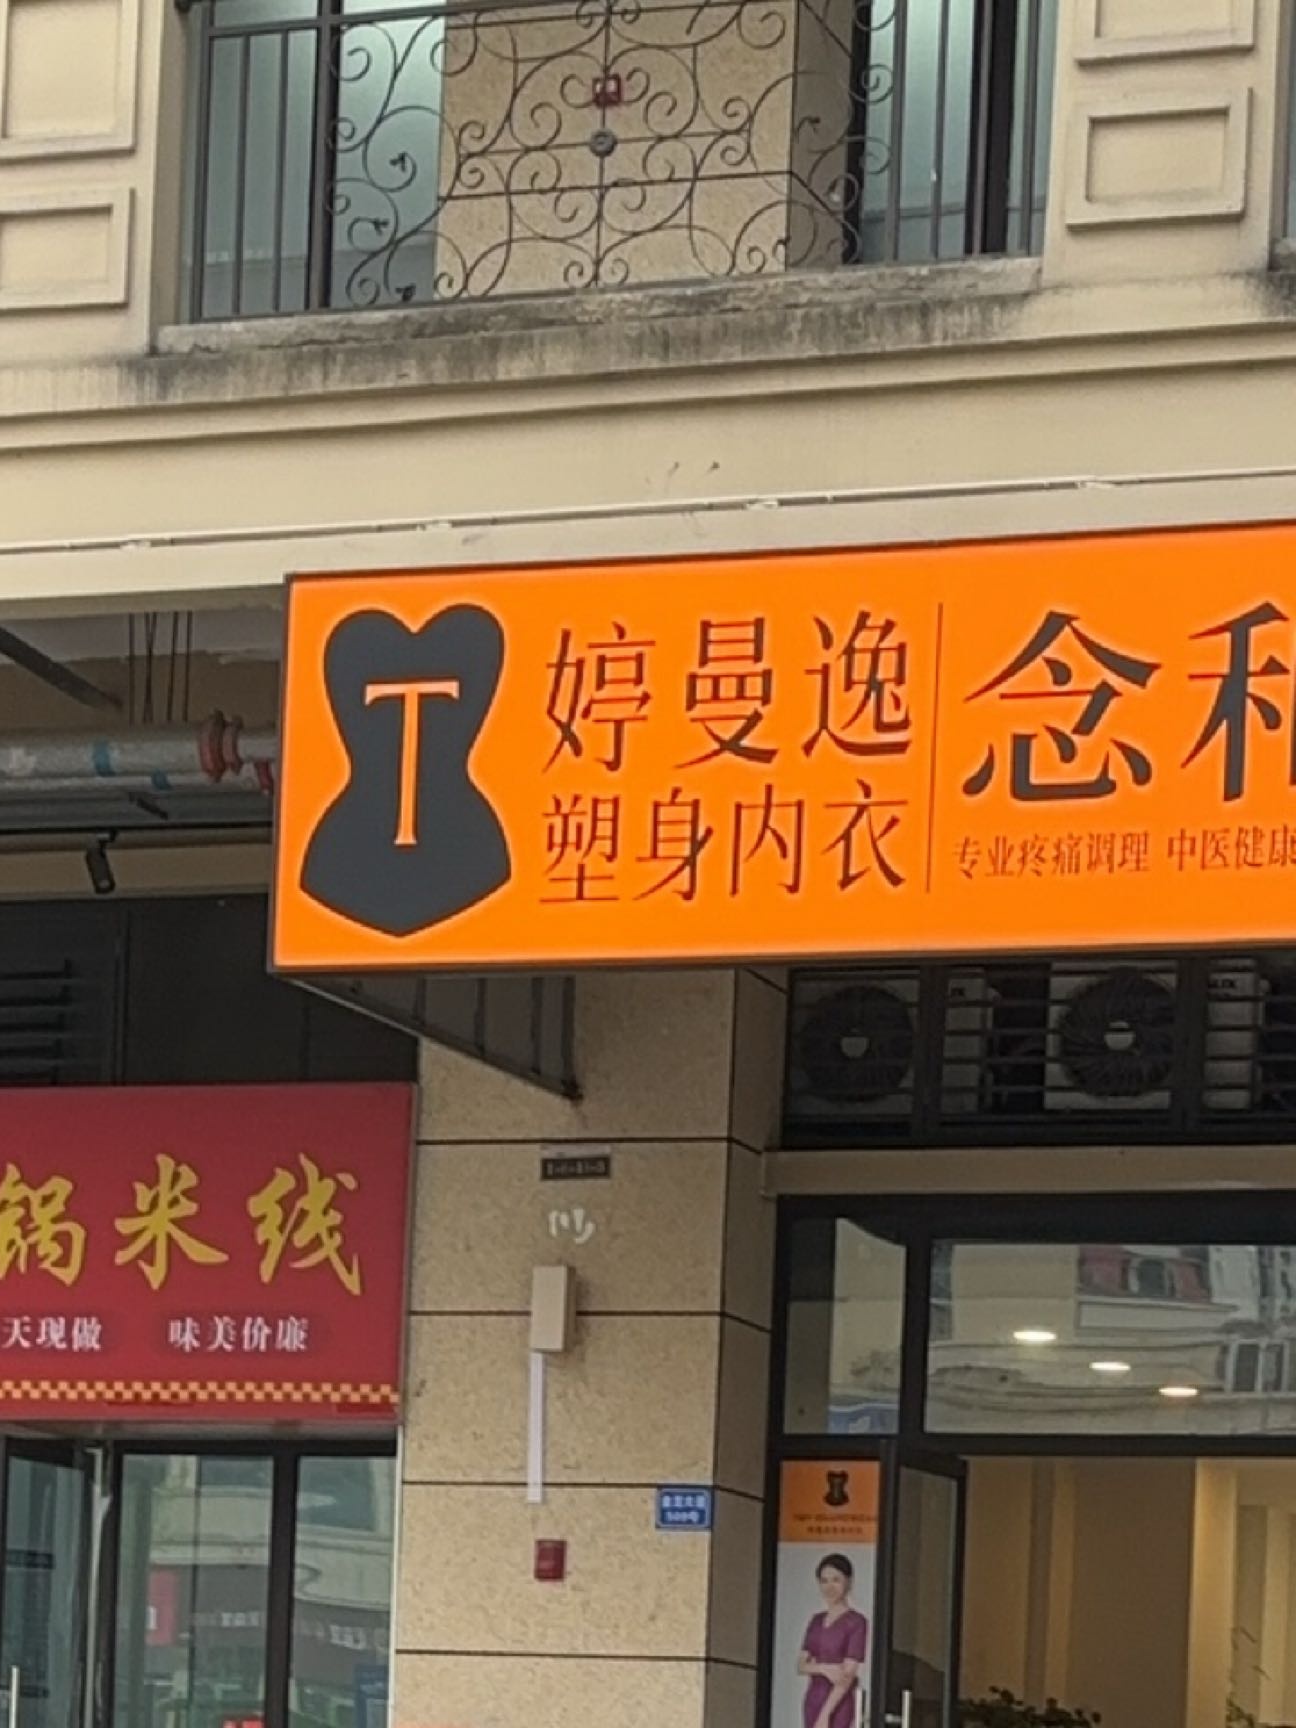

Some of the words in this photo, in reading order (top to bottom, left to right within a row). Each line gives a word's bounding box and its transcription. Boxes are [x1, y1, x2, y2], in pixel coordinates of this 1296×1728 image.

[542, 608, 912, 773] 婷曼逸
[364, 679, 460, 847] T
[539, 779, 909, 905] 塑身内衣
[954, 830, 1151, 879] 专业疼痛调理
[168, 1316, 310, 1353] 味美价廉
